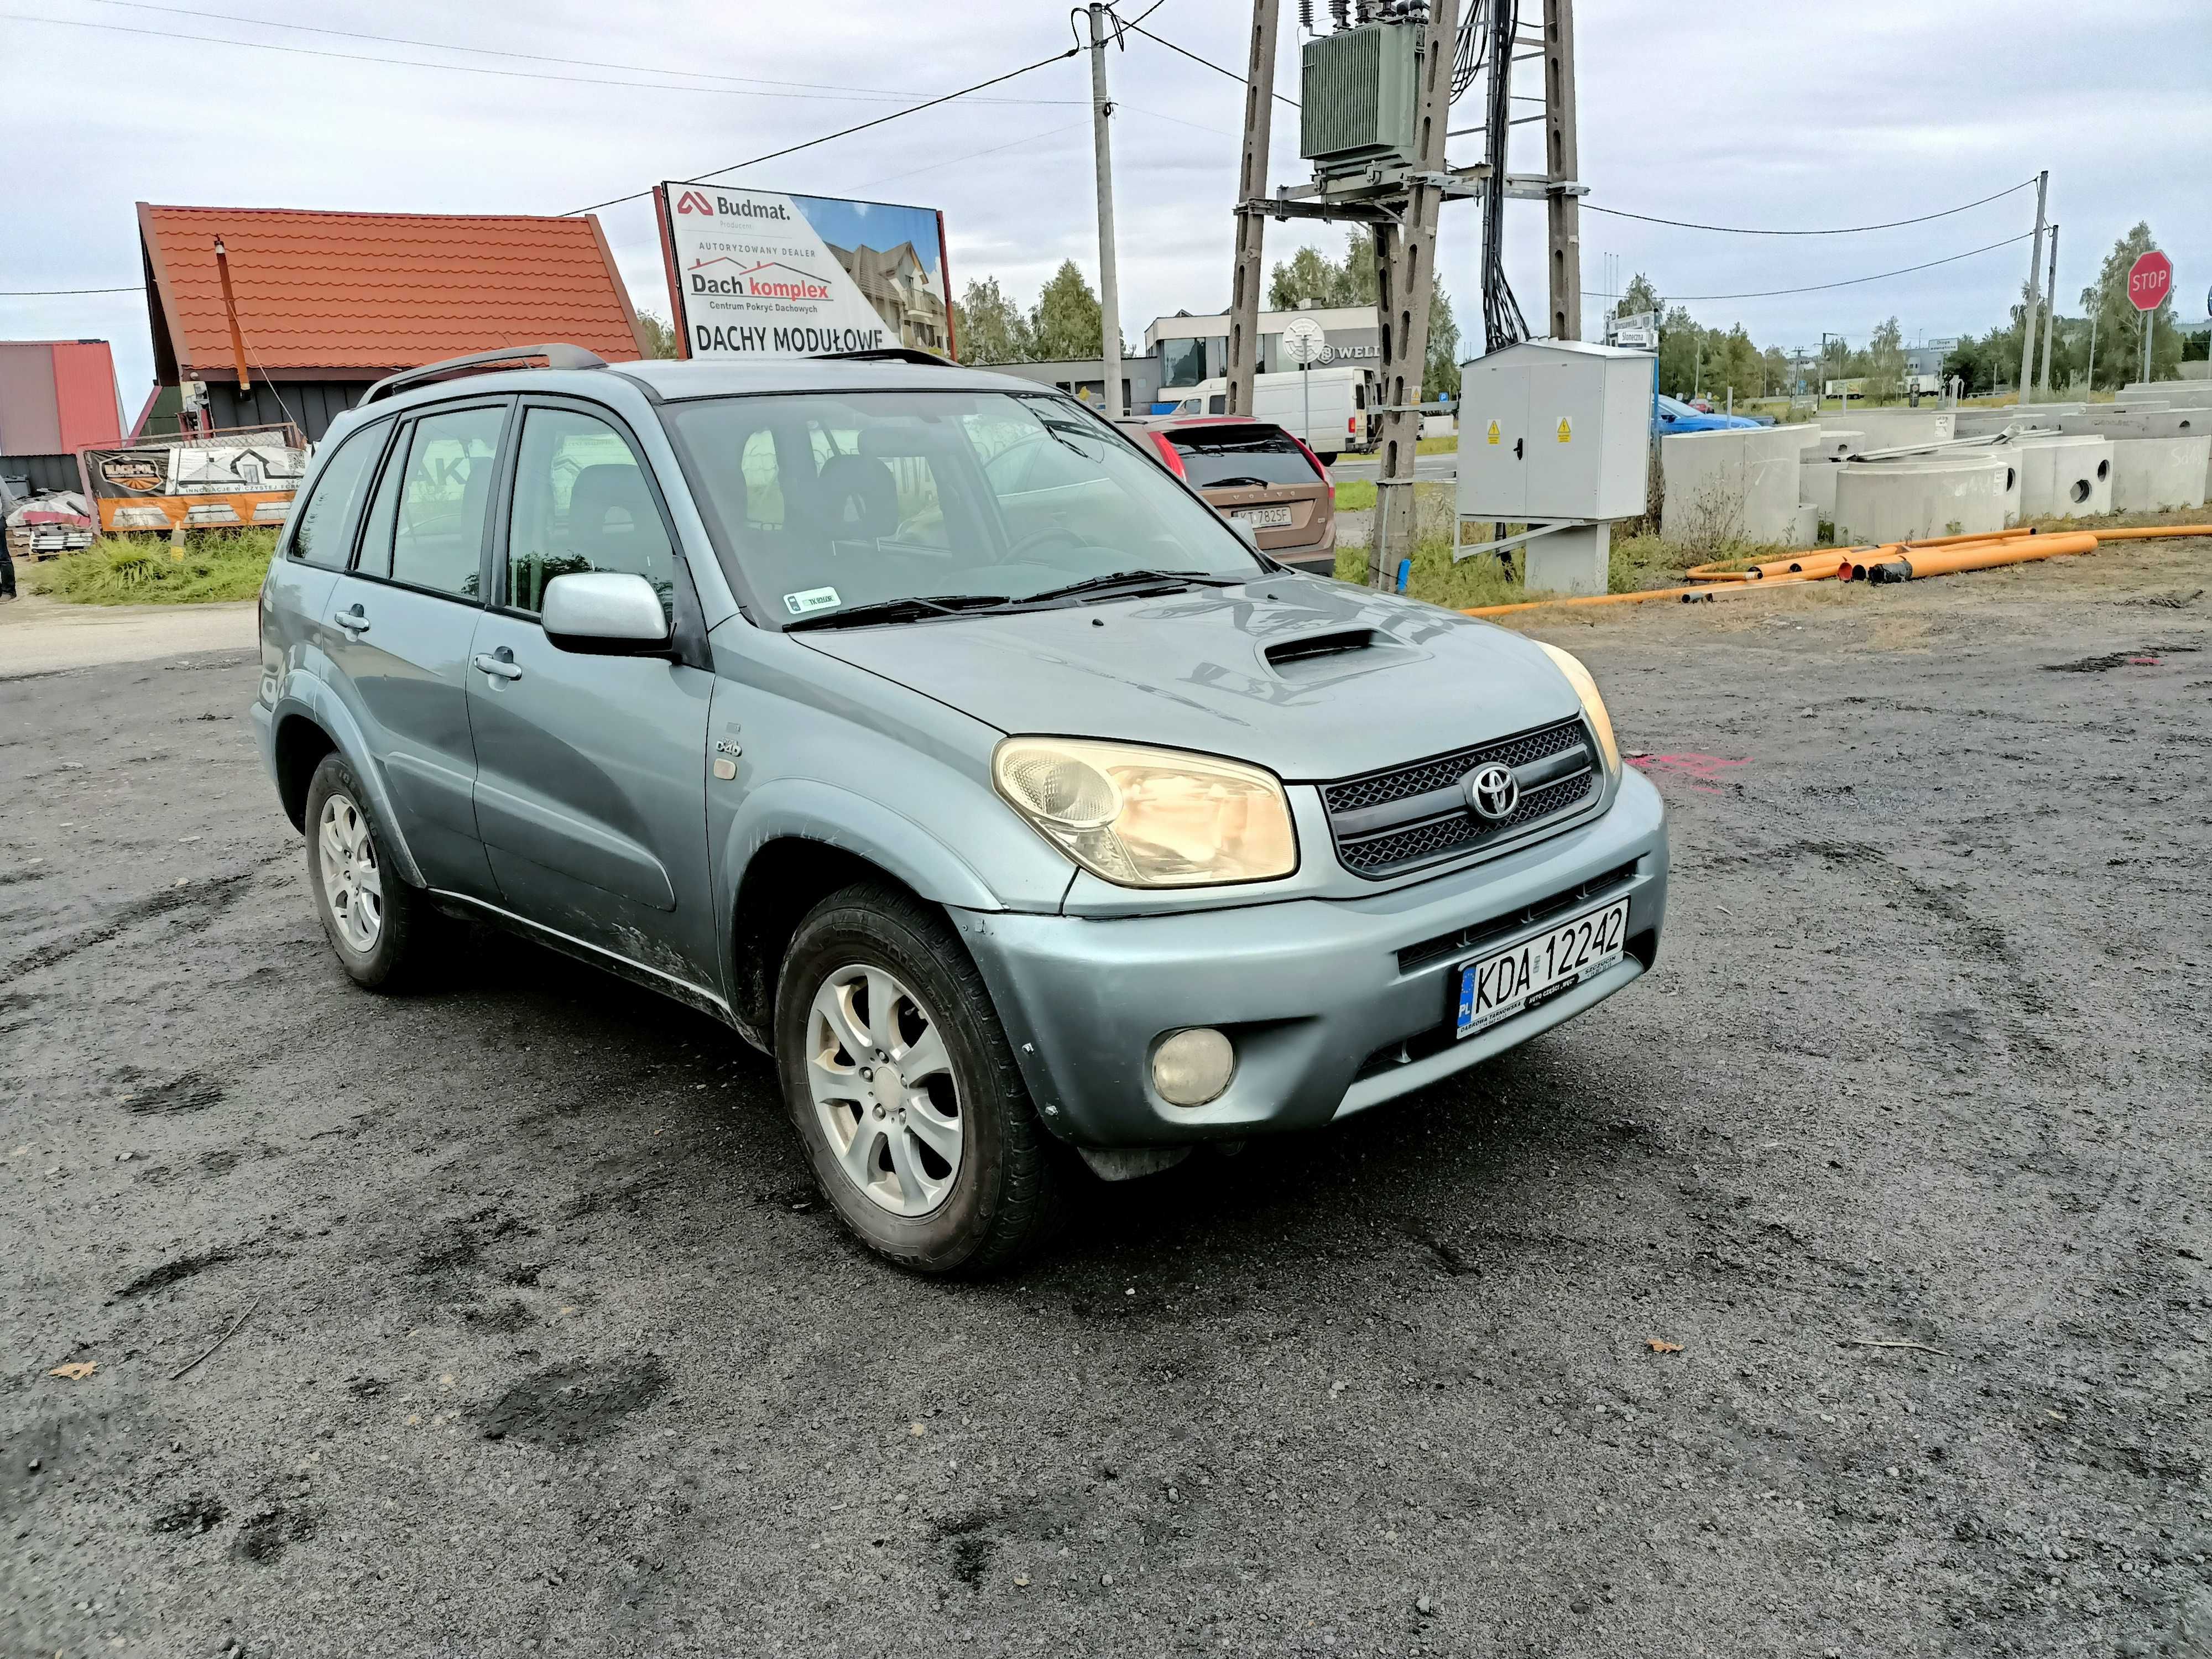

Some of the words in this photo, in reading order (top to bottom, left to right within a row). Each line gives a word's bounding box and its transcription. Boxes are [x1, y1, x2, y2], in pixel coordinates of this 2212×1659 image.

[717, 196, 790, 220] Budmat.
[699, 242, 777, 254] AUTORYZOWANY
[782, 248, 816, 257] DEALER
[691, 274, 743, 294] Dach
[749, 276, 828, 301] komplex
[2132, 270, 2167, 291] STOP
[709, 301, 744, 310] Centrum
[747, 302, 773, 313] Pokryć
[775, 304, 818, 315] Dachowych
[696, 325, 766, 351] DACHY
[774, 327, 883, 352] MODUŁOWE
[1233, 491, 1296, 500] VOLVO
[1258, 509, 1287, 523] 7825F
[1476, 947, 1530, 1014] KDA
[1546, 907, 1623, 980] 12242
[1528, 993, 1542, 1004] AUTO
[1459, 1003, 1470, 1018] PL
